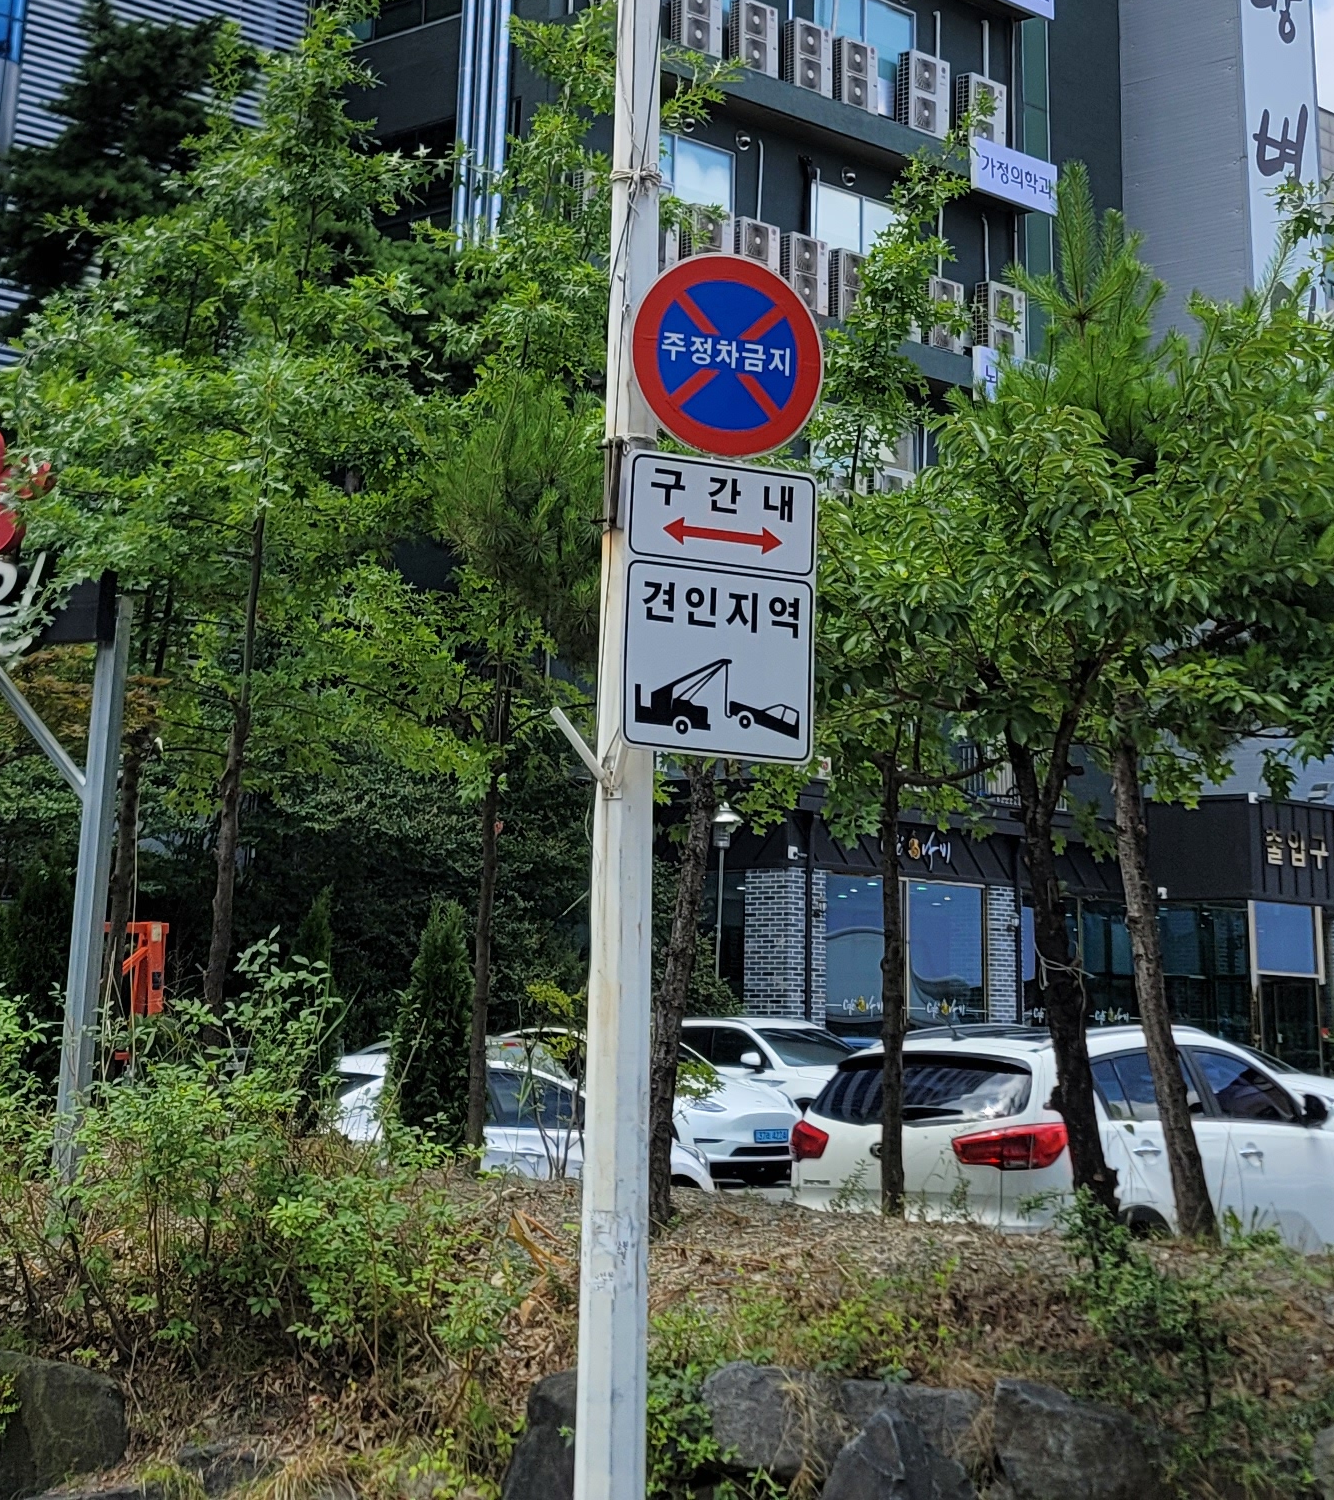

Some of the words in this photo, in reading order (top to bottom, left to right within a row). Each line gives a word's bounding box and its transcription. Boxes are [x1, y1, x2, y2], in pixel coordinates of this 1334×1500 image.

[981, 154, 1052, 200] 가정의학과
[660, 330, 793, 377] 주정차금지
[641, 580, 801, 639] 견인지역
[1265, 829, 1330, 870] 출입구
